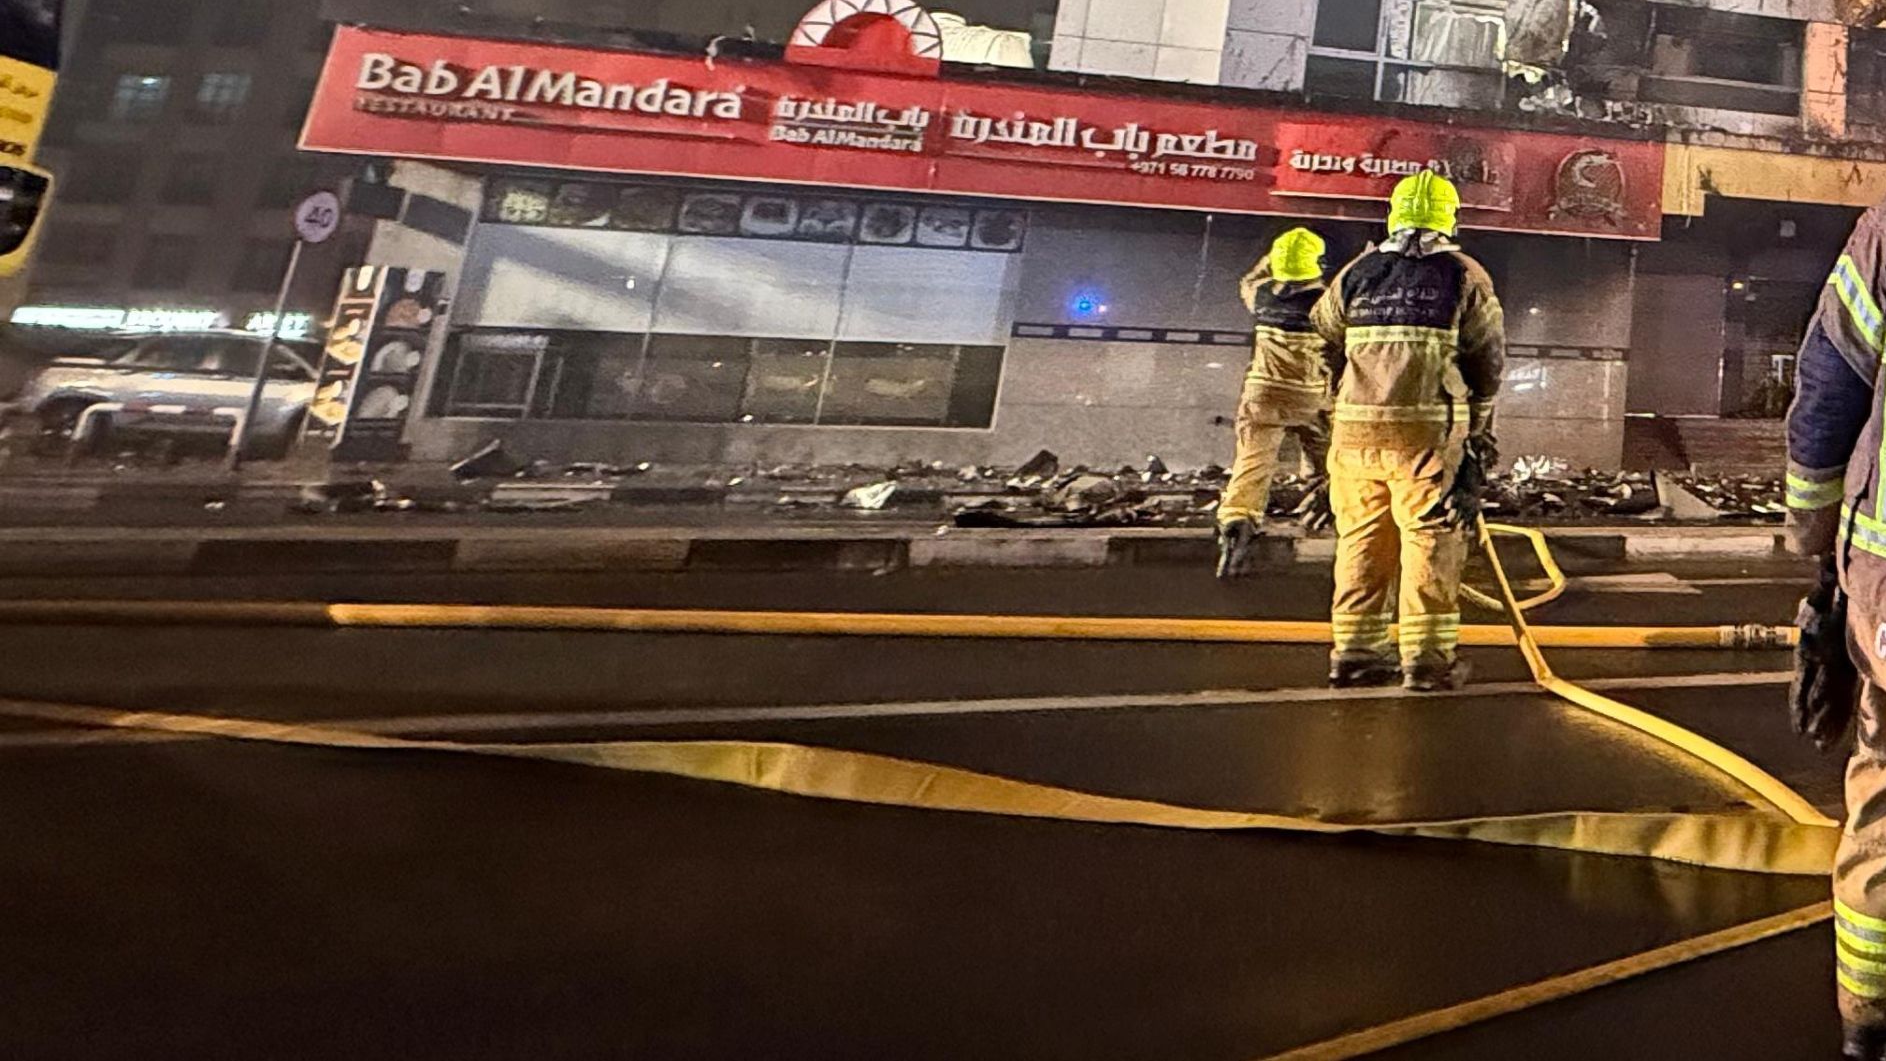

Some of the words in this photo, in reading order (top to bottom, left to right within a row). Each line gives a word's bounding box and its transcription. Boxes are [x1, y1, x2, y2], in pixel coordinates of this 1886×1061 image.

[356, 53, 459, 95] Bab
[770, 124, 813, 144] Bab
[1081, 124, 1150, 160] باب
[1155, 126, 1258, 163] مطعم
[303, 205, 333, 229] 40
